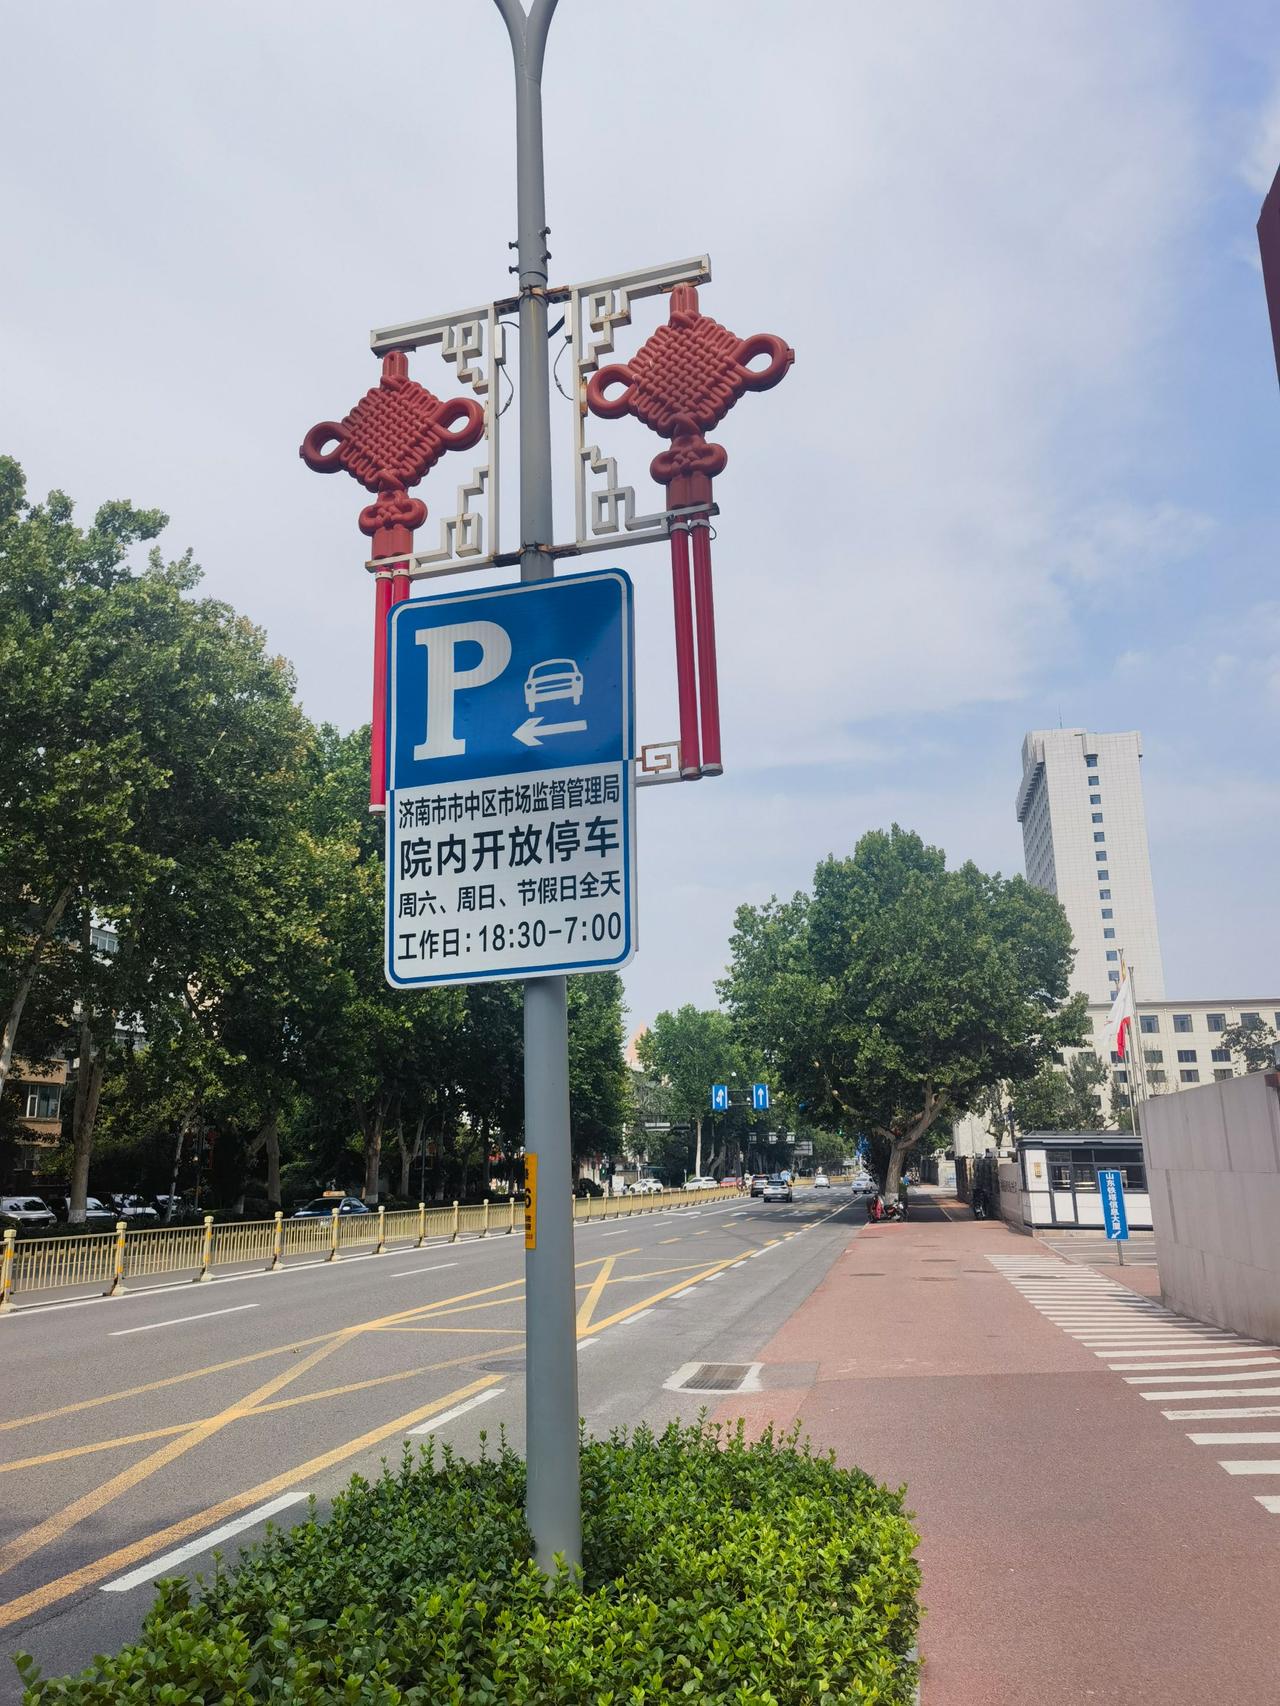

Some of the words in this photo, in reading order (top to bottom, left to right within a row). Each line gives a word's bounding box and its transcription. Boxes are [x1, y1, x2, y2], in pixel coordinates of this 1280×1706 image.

[413, 620, 512, 761] P
[399, 774, 619, 828] 济南市市中区市场监督管理局
[400, 816, 620, 880] 院内开放停车
[398, 870, 621, 919] 周六、周日、节假日全天
